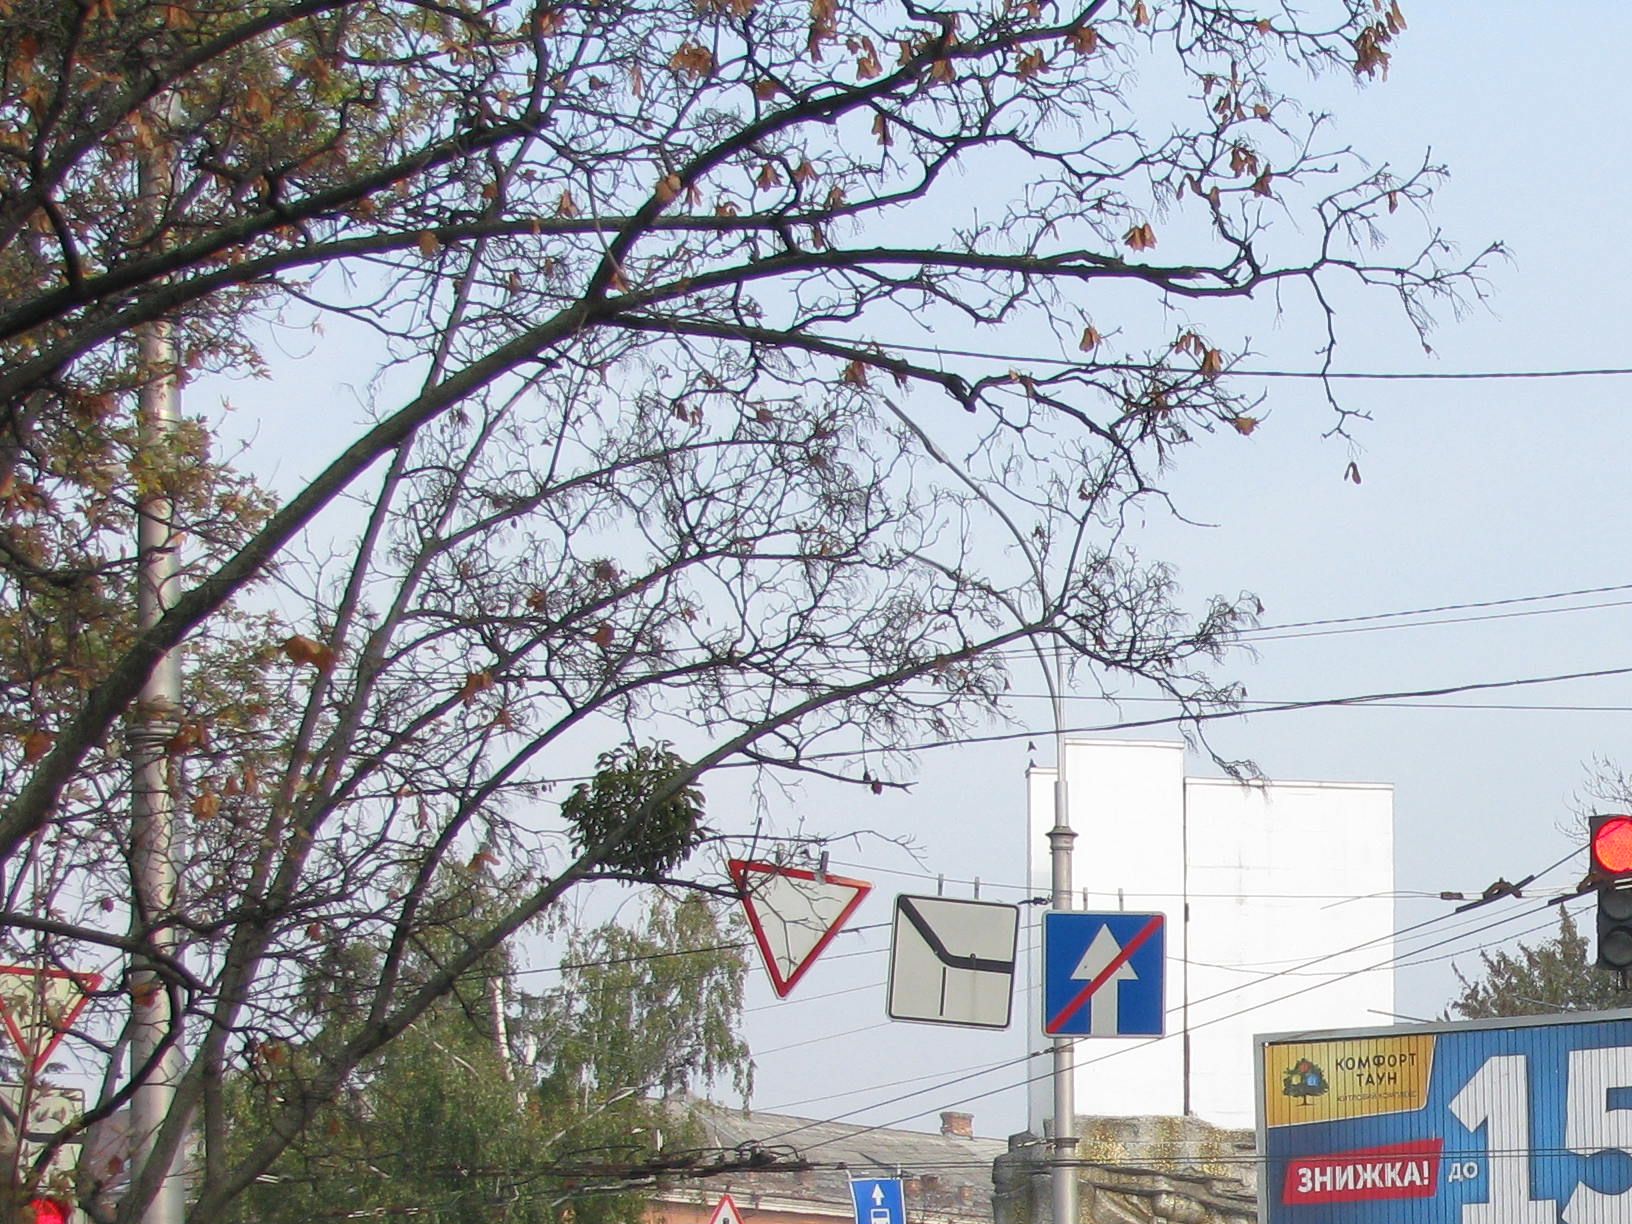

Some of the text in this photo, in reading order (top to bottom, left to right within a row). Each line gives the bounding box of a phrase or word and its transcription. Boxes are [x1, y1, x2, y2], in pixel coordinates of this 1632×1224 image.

[1336, 1053, 1416, 1072] КОМФОРТ
[1356, 1072, 1397, 1087] ТАУН
[1297, 1160, 1430, 1194] ЗНИЖКА!
